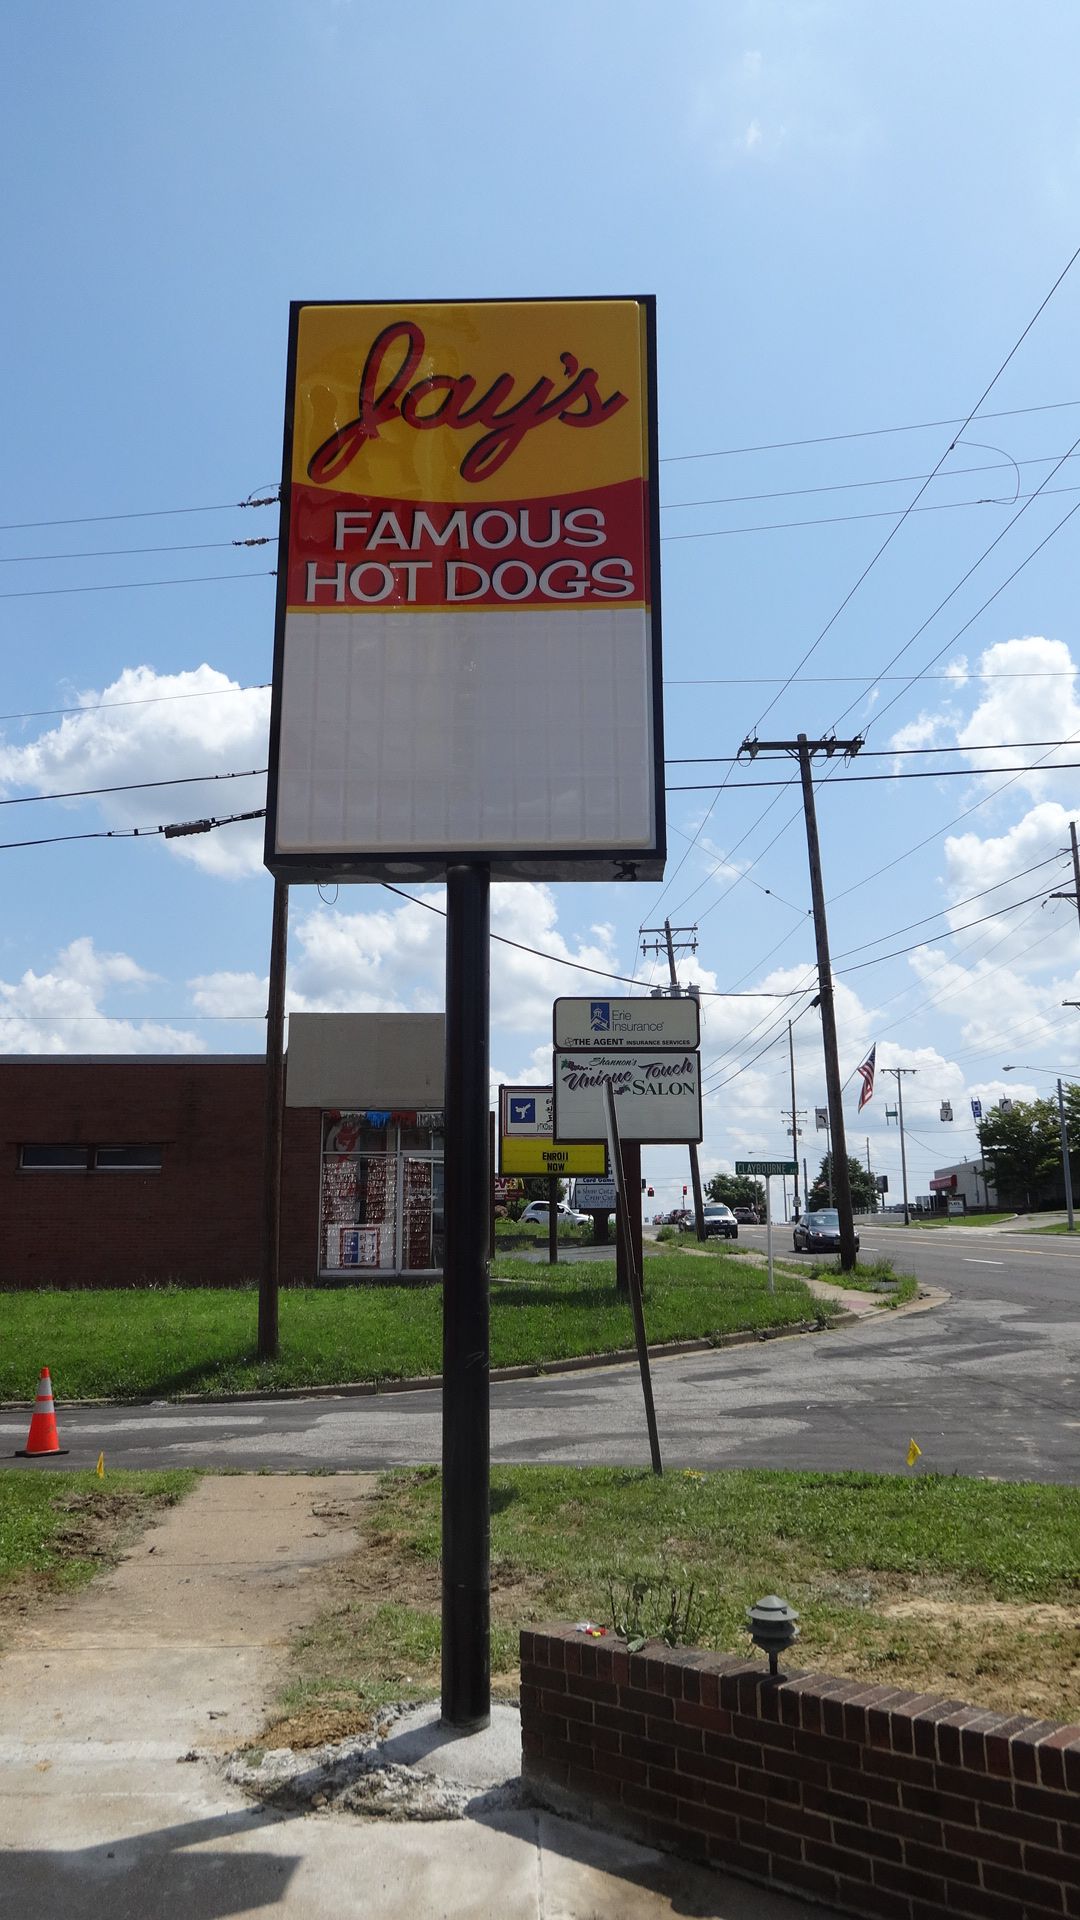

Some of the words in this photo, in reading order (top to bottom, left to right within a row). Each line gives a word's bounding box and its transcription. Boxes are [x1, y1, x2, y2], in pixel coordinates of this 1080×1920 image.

[307, 321, 629, 484] Jay's
[335, 507, 607, 551] FAMOUS
[305, 560, 433, 602] HOT
[445, 558, 635, 601] DOGS
[612, 1010, 631, 1020] Erie
[612, 1021, 663, 1032] Insurance
[574, 1038, 591, 1046] THE
[593, 1038, 624, 1046] AGENT
[589, 1057, 637, 1067] Shannon's
[563, 1070, 633, 1091] Unique
[638, 1057, 694, 1080] Touch
[632, 1080, 696, 1096] SALON
[547, 1163, 565, 1172] NOW
[737, 1163, 786, 1174] CLAYBOURNE
